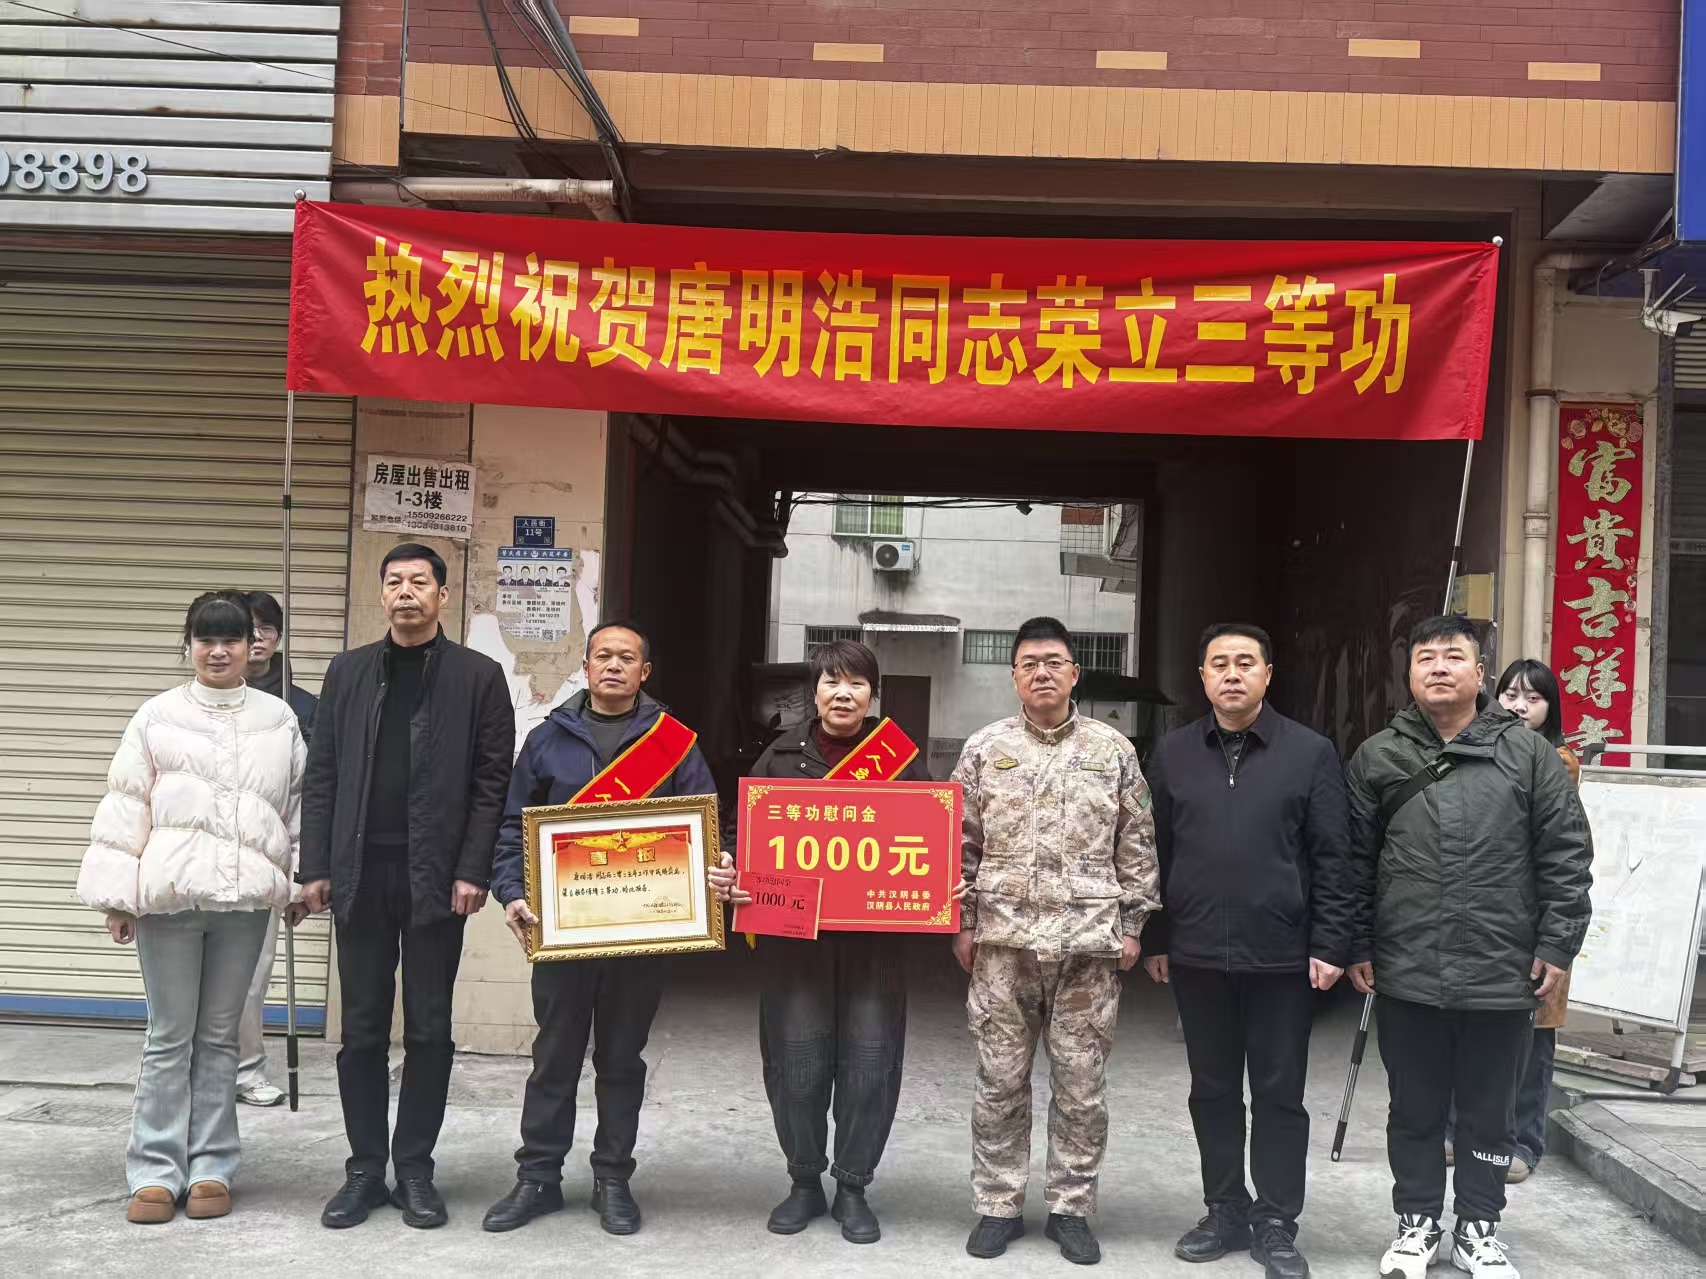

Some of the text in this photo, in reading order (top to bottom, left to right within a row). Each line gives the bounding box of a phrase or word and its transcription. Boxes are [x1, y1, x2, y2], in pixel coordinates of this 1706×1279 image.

[360, 236, 1411, 396] 热烈祝贺唐明浩同志荣立三等功
[373, 462, 470, 491] 房屋出售出租
[395, 490, 443, 510] 1-3楼
[525, 528, 543, 537] 11号
[767, 804, 877, 823] 三等功慰问金
[768, 835, 930, 876] 1000元
[755, 891, 786, 907] 1000
[866, 889, 931, 900] 中共汉阴县委
[866, 901, 931, 911] 汉阴县人民政府
